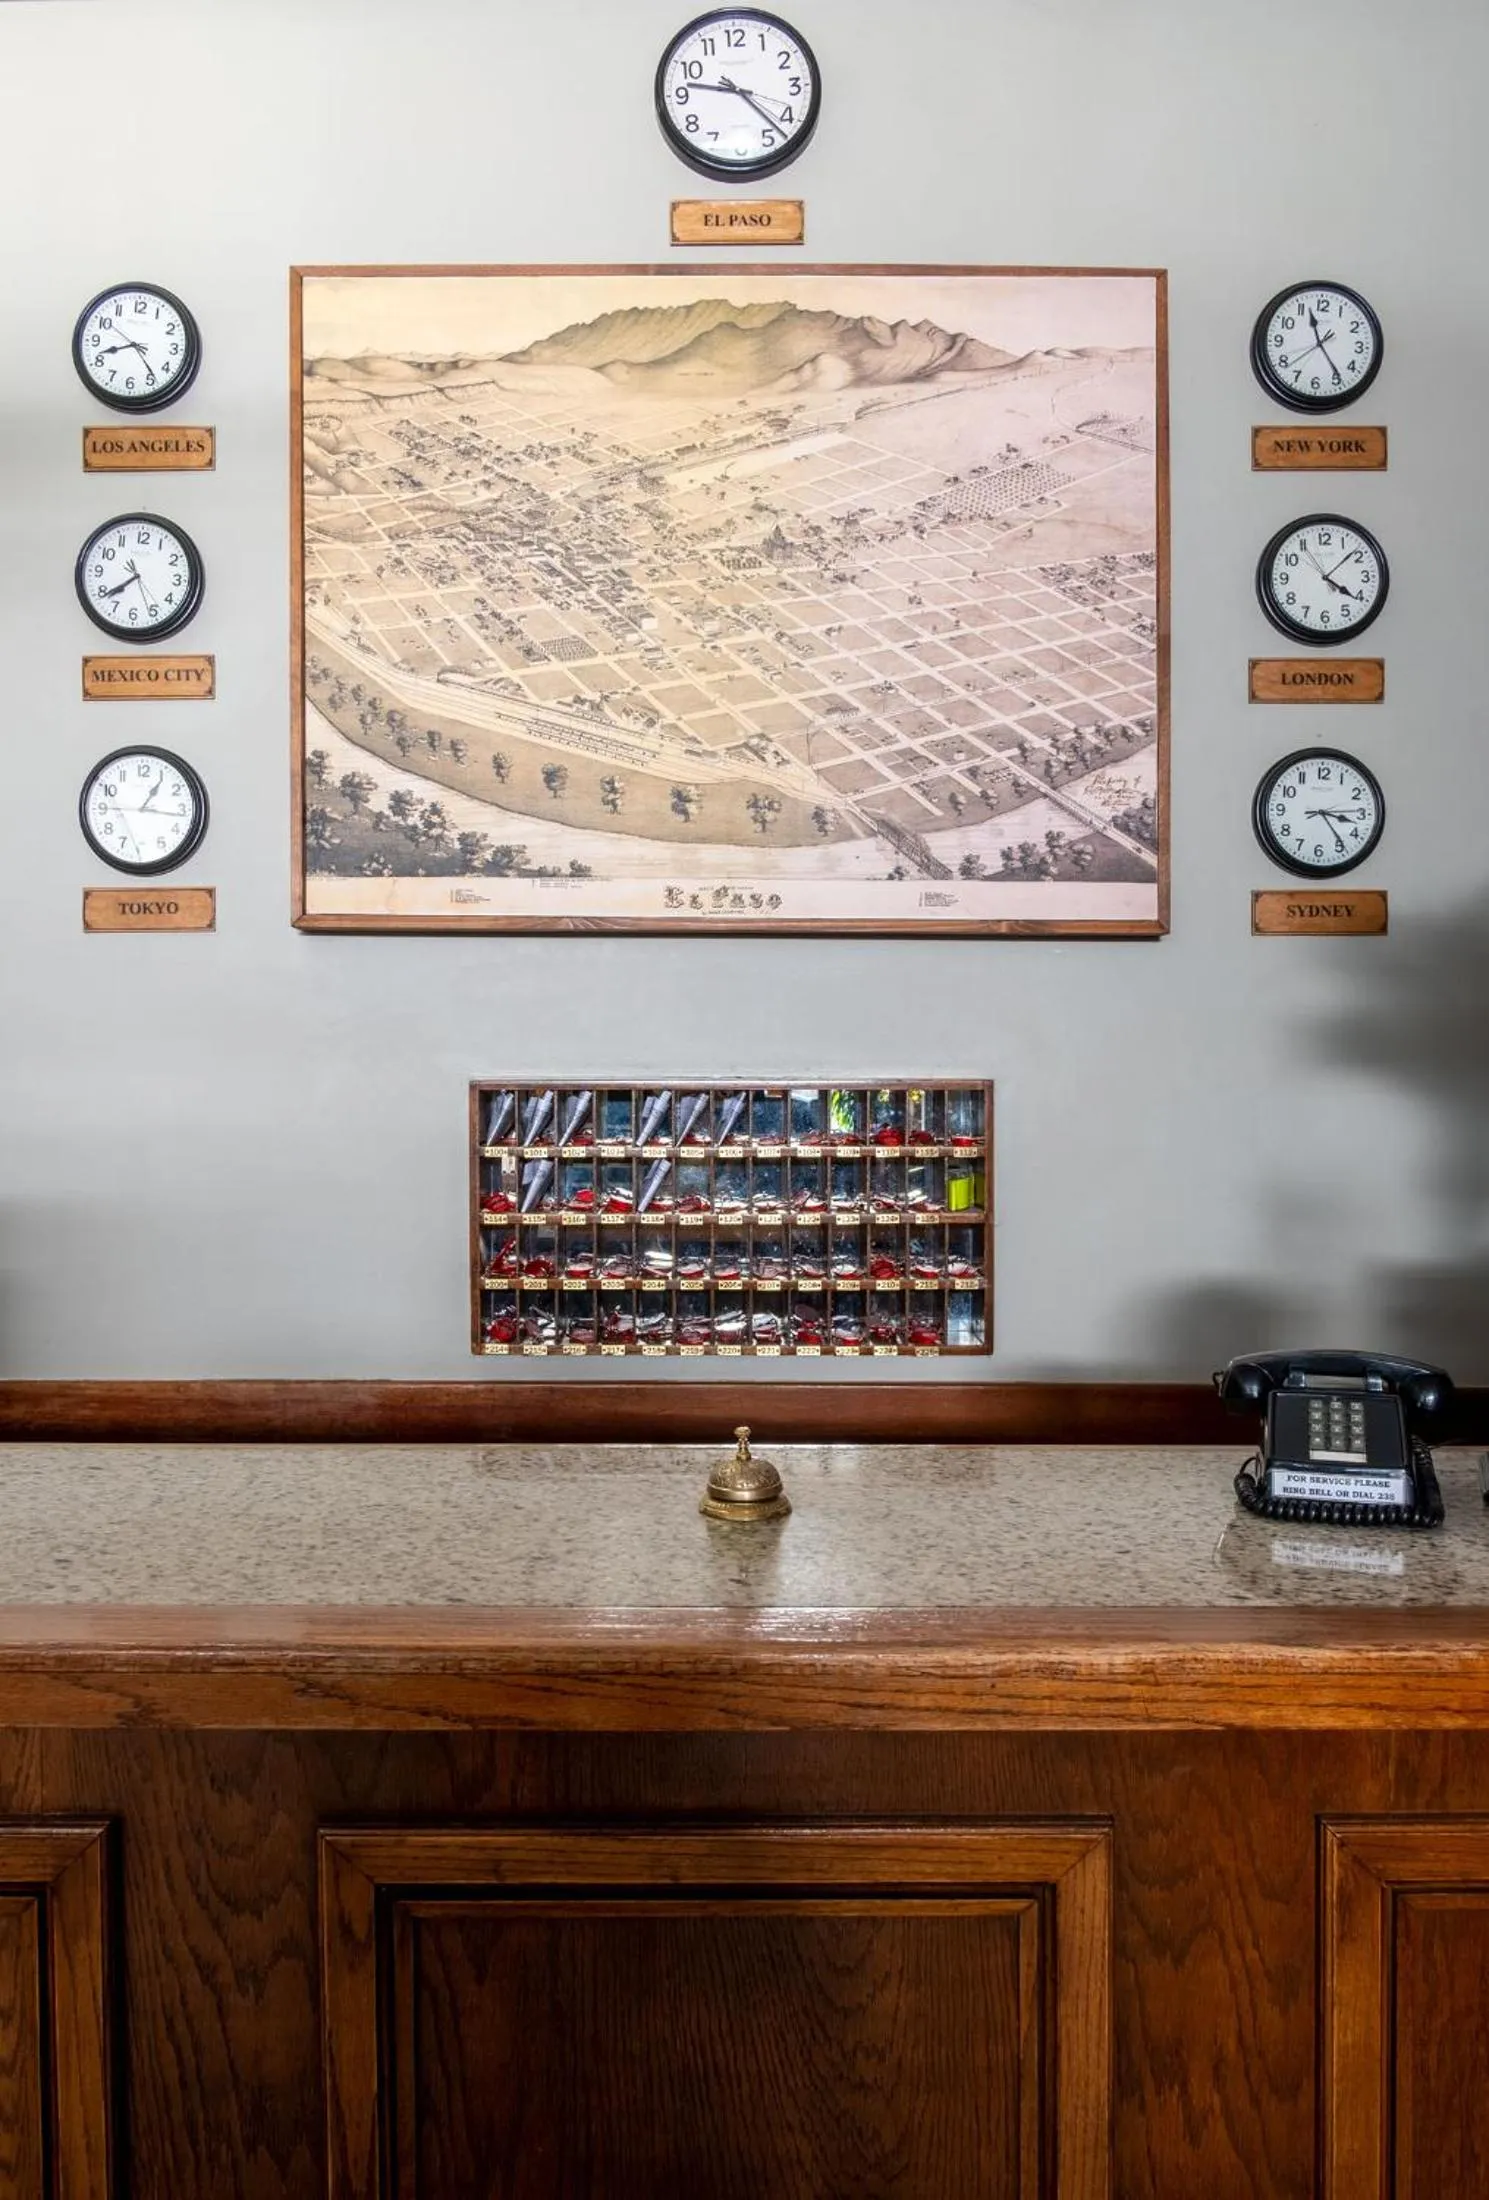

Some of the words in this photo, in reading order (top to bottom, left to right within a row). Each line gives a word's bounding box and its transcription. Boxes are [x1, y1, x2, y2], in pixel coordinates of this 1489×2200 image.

[724, 29, 746, 47] 12
[777, 51, 791, 70] 2
[681, 60, 703, 80] 10
[788, 77, 801, 96] 3
[675, 87, 689, 105] 9
[780, 106, 793, 124] 4
[685, 114, 700, 132] 8
[762, 129, 775, 147] 5
[703, 214, 725, 227] EL
[729, 213, 772, 227] PASO
[134, 301, 147, 314] 12
[1316, 299, 1330, 312] 12
[99, 317, 112, 330] 10
[165, 323, 176, 335] 2
[1281, 316, 1295, 330] 10
[1350, 321, 1359, 334] 2
[92, 334, 101, 347] 9
[1274, 334, 1284, 347] 9
[169, 343, 179, 356] 3
[1354, 341, 1364, 354] 3
[95, 354, 105, 367] 8
[1278, 354, 1289, 368] 8
[1347, 360, 1356, 372] 4
[161, 361, 170, 374] 4
[108, 369, 117, 383] 7
[145, 374, 156, 386] 5
[1293, 370, 1302, 383] 7
[1331, 374, 1341, 386] 5
[125, 377, 134, 389] 6
[1311, 377, 1320, 390] 6
[92, 440, 124, 454] LOS
[126, 439, 205, 453] ANGELES
[1273, 440, 1314, 453] NEW
[1316, 440, 1367, 453] YORK
[137, 532, 151, 545] 12
[1318, 533, 1332, 546] 12
[102, 547, 115, 560] 10
[1285, 553, 1299, 567] 10
[1354, 550, 1363, 563] 2
[168, 554, 179, 567] 2
[95, 565, 104, 578] 9
[1361, 570, 1370, 583] 3
[172, 574, 182, 587] 3
[1279, 572, 1289, 585] 9
[98, 585, 108, 598] 8
[1355, 589, 1364, 602] 4
[165, 592, 174, 605] 4
[1286, 592, 1296, 605] 8
[111, 601, 120, 613] 7
[149, 604, 158, 617] 5
[1301, 605, 1310, 619] 7
[1340, 604, 1350, 617] 5
[129, 608, 137, 620] 6
[1320, 610, 1330, 623] 6
[91, 670, 159, 683] MEXICO
[164, 668, 205, 682] CITY
[1281, 672, 1354, 686] LONDON
[138, 765, 150, 778] 12
[1317, 767, 1331, 780] 12
[104, 784, 117, 797] 10
[172, 784, 181, 796] 2
[1283, 785, 1296, 798] 10
[1352, 787, 1361, 800] 2
[98, 803, 108, 816] 9
[178, 803, 186, 816] 3
[1275, 803, 1286, 816] 9
[1357, 808, 1366, 821] 3
[103, 822, 114, 835] 8
[171, 823, 180, 835] 4
[1280, 824, 1291, 836] 8
[1350, 827, 1359, 840] 4
[119, 836, 128, 849] 7
[157, 836, 166, 849] 5
[1295, 838, 1304, 851] 7
[1335, 840, 1345, 853] 5
[1314, 845, 1324, 857] 6
[118, 902, 179, 915] TOKYO
[1286, 905, 1357, 918] SYDNEY
[1287, 1474, 1307, 1483] FOR
[1309, 1476, 1352, 1486] SERVICE
[1354, 1479, 1391, 1488] PLEASE
[1309, 1488, 1333, 1497] BELL
[1352, 1491, 1375, 1499] DIAL
